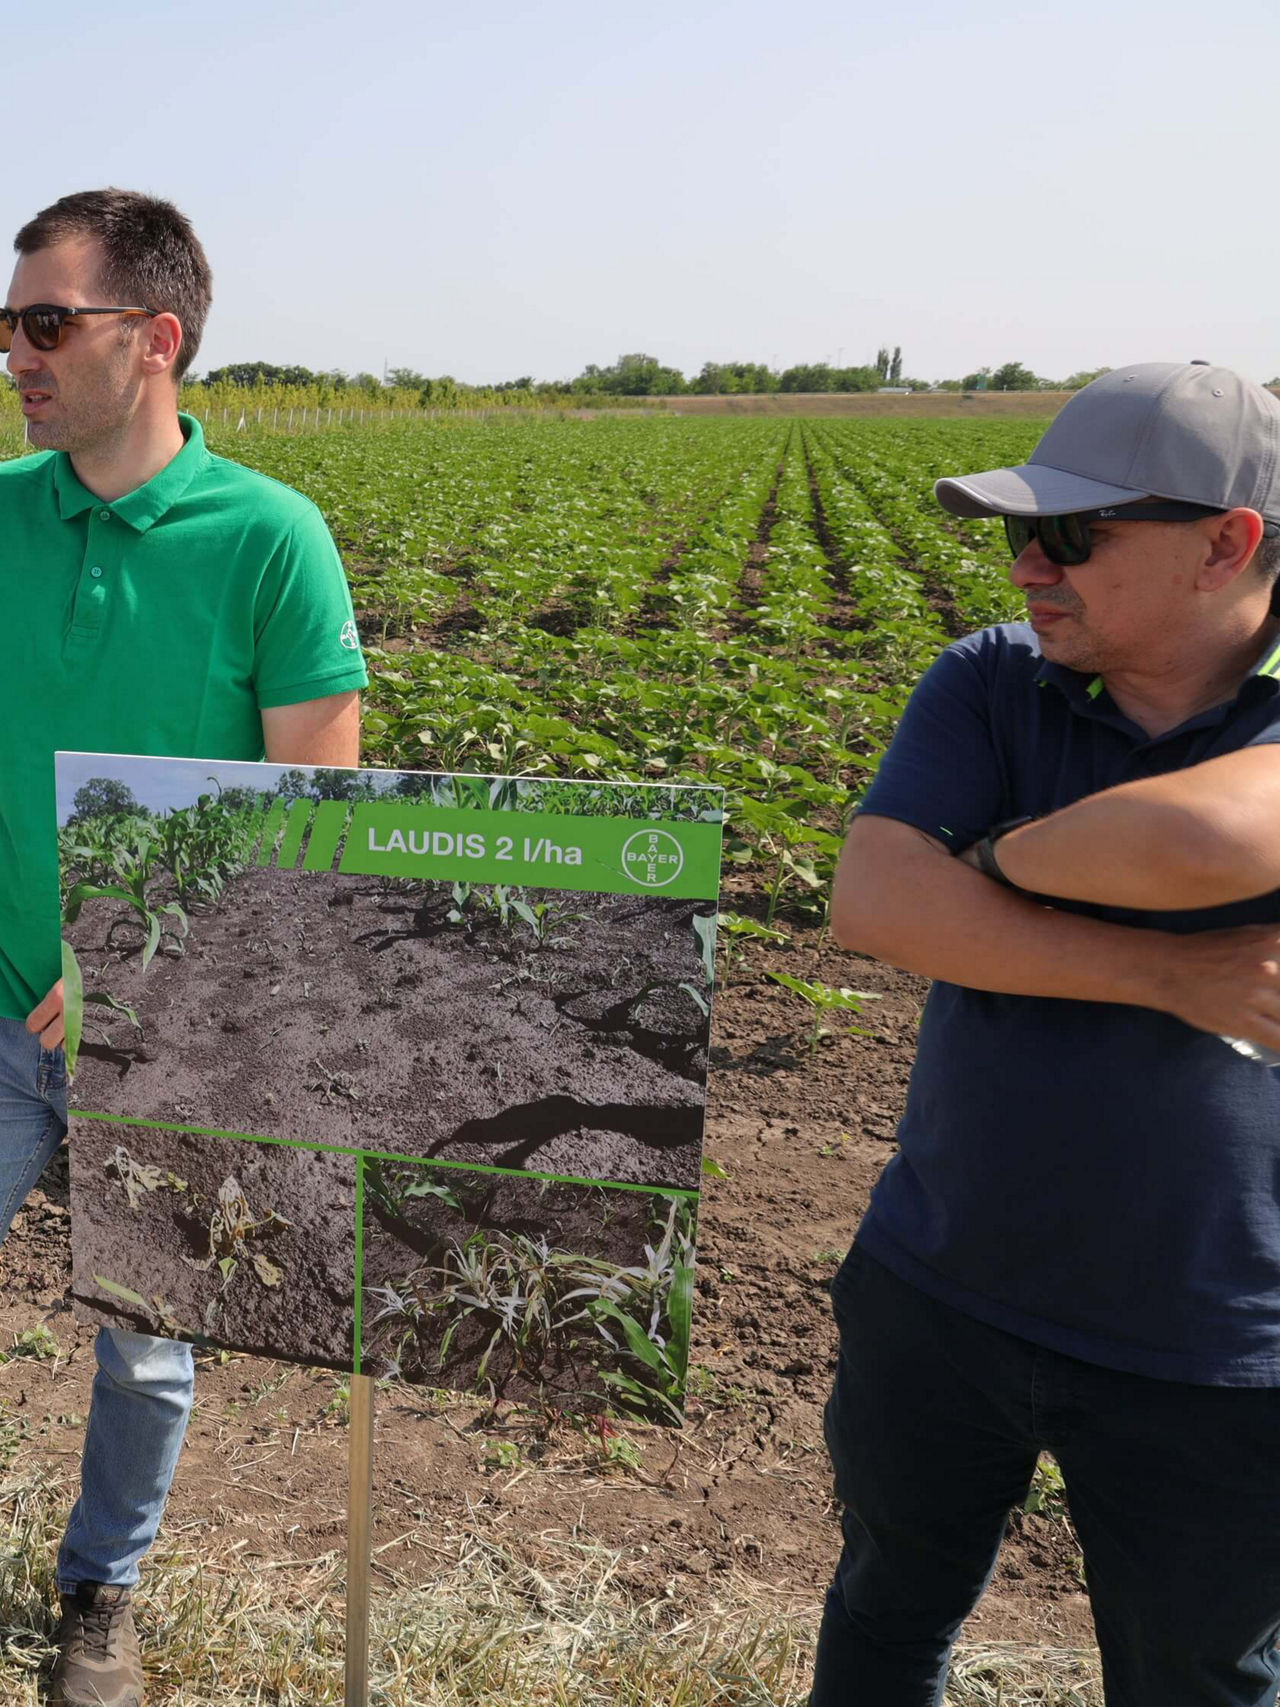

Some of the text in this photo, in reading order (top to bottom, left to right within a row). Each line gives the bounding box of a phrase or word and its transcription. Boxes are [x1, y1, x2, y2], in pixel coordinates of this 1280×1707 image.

[368, 827, 583, 866] LAUDIS 2 l/ha
[627, 851, 679, 865] BAYER
[646, 833, 659, 883] BAYER
